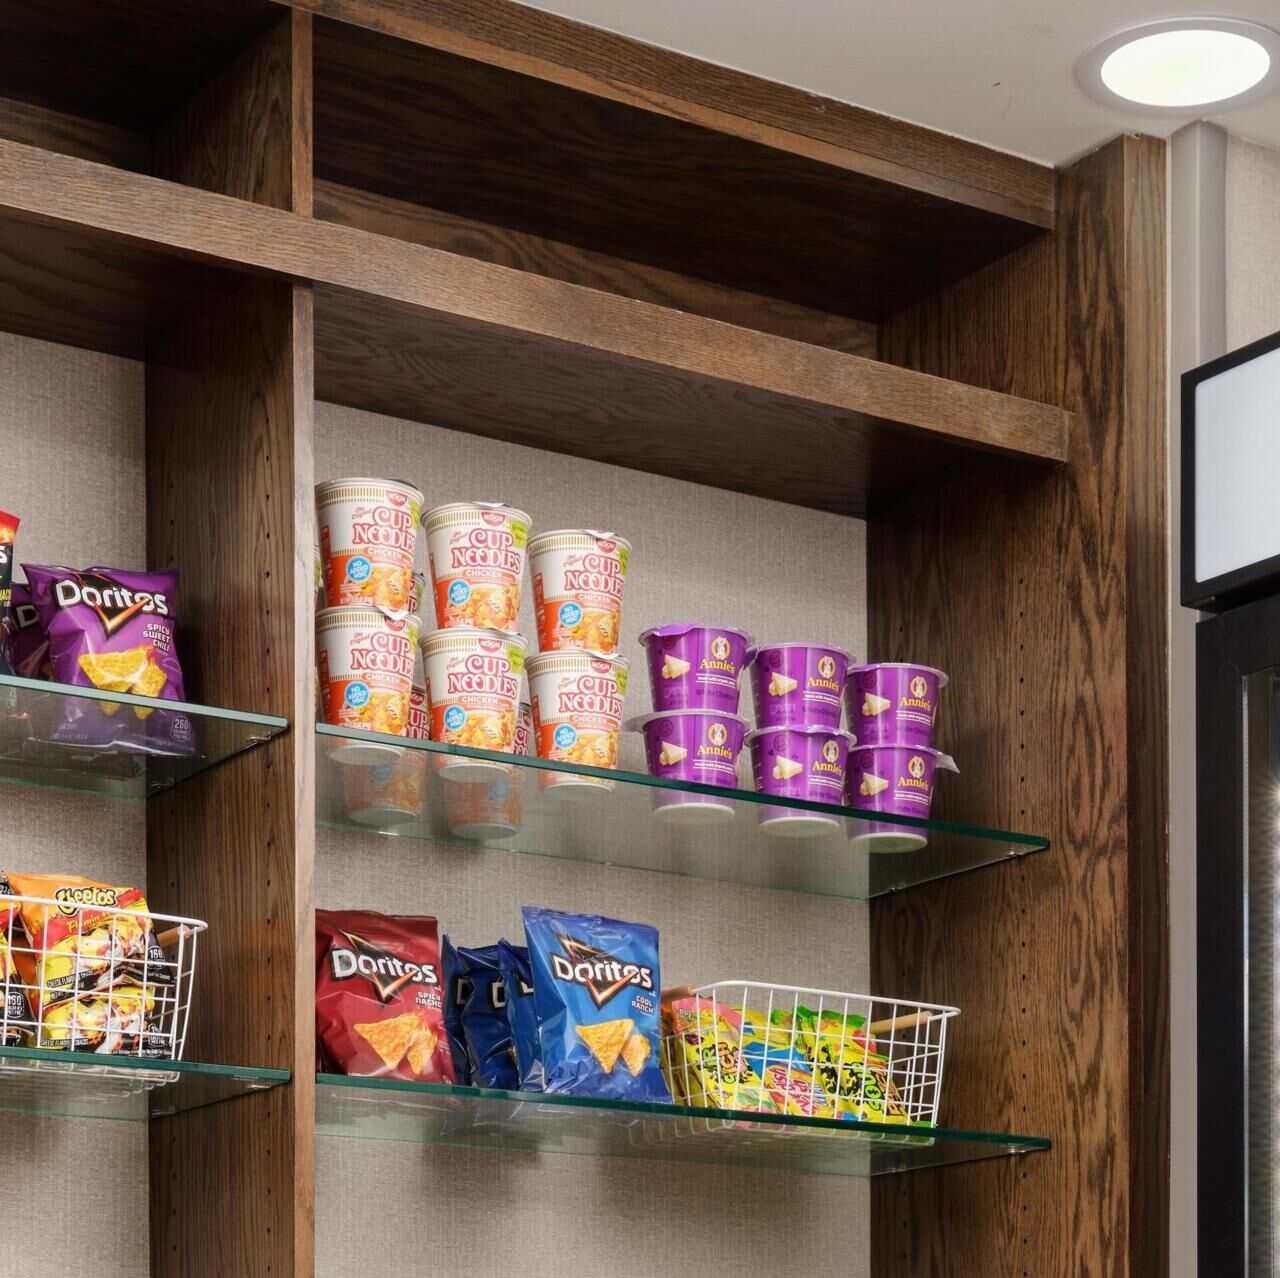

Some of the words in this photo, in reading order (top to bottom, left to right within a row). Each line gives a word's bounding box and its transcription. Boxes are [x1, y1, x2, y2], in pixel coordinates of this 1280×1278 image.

[372, 506, 413, 530] CUP
[468, 528, 514, 550] CUP
[451, 547, 521, 575] NOODLES
[582, 553, 621, 578] CUP
[55, 578, 169, 615] Doritos
[143, 630, 171, 643] SWEET
[147, 623, 170, 635] SPICY
[153, 639, 170, 652] CHILI
[370, 631, 411, 657] CUP
[465, 654, 511, 676] CUP
[700, 658, 736, 674] Annie's
[448, 672, 518, 700] NOODLES
[577, 674, 618, 697] CUP
[807, 677, 840, 692] Annie's
[900, 696, 932, 711] Annie's
[409, 708, 428, 726] UP
[697, 744, 733, 759] Annie's
[812, 760, 842, 776] Annie's
[898, 776, 929, 791] Annie's
[331, 948, 437, 983] Doritos
[551, 953, 653, 988] Doritos
[631, 1001, 655, 1015] RANCH
[635, 994, 654, 1007] COOL
